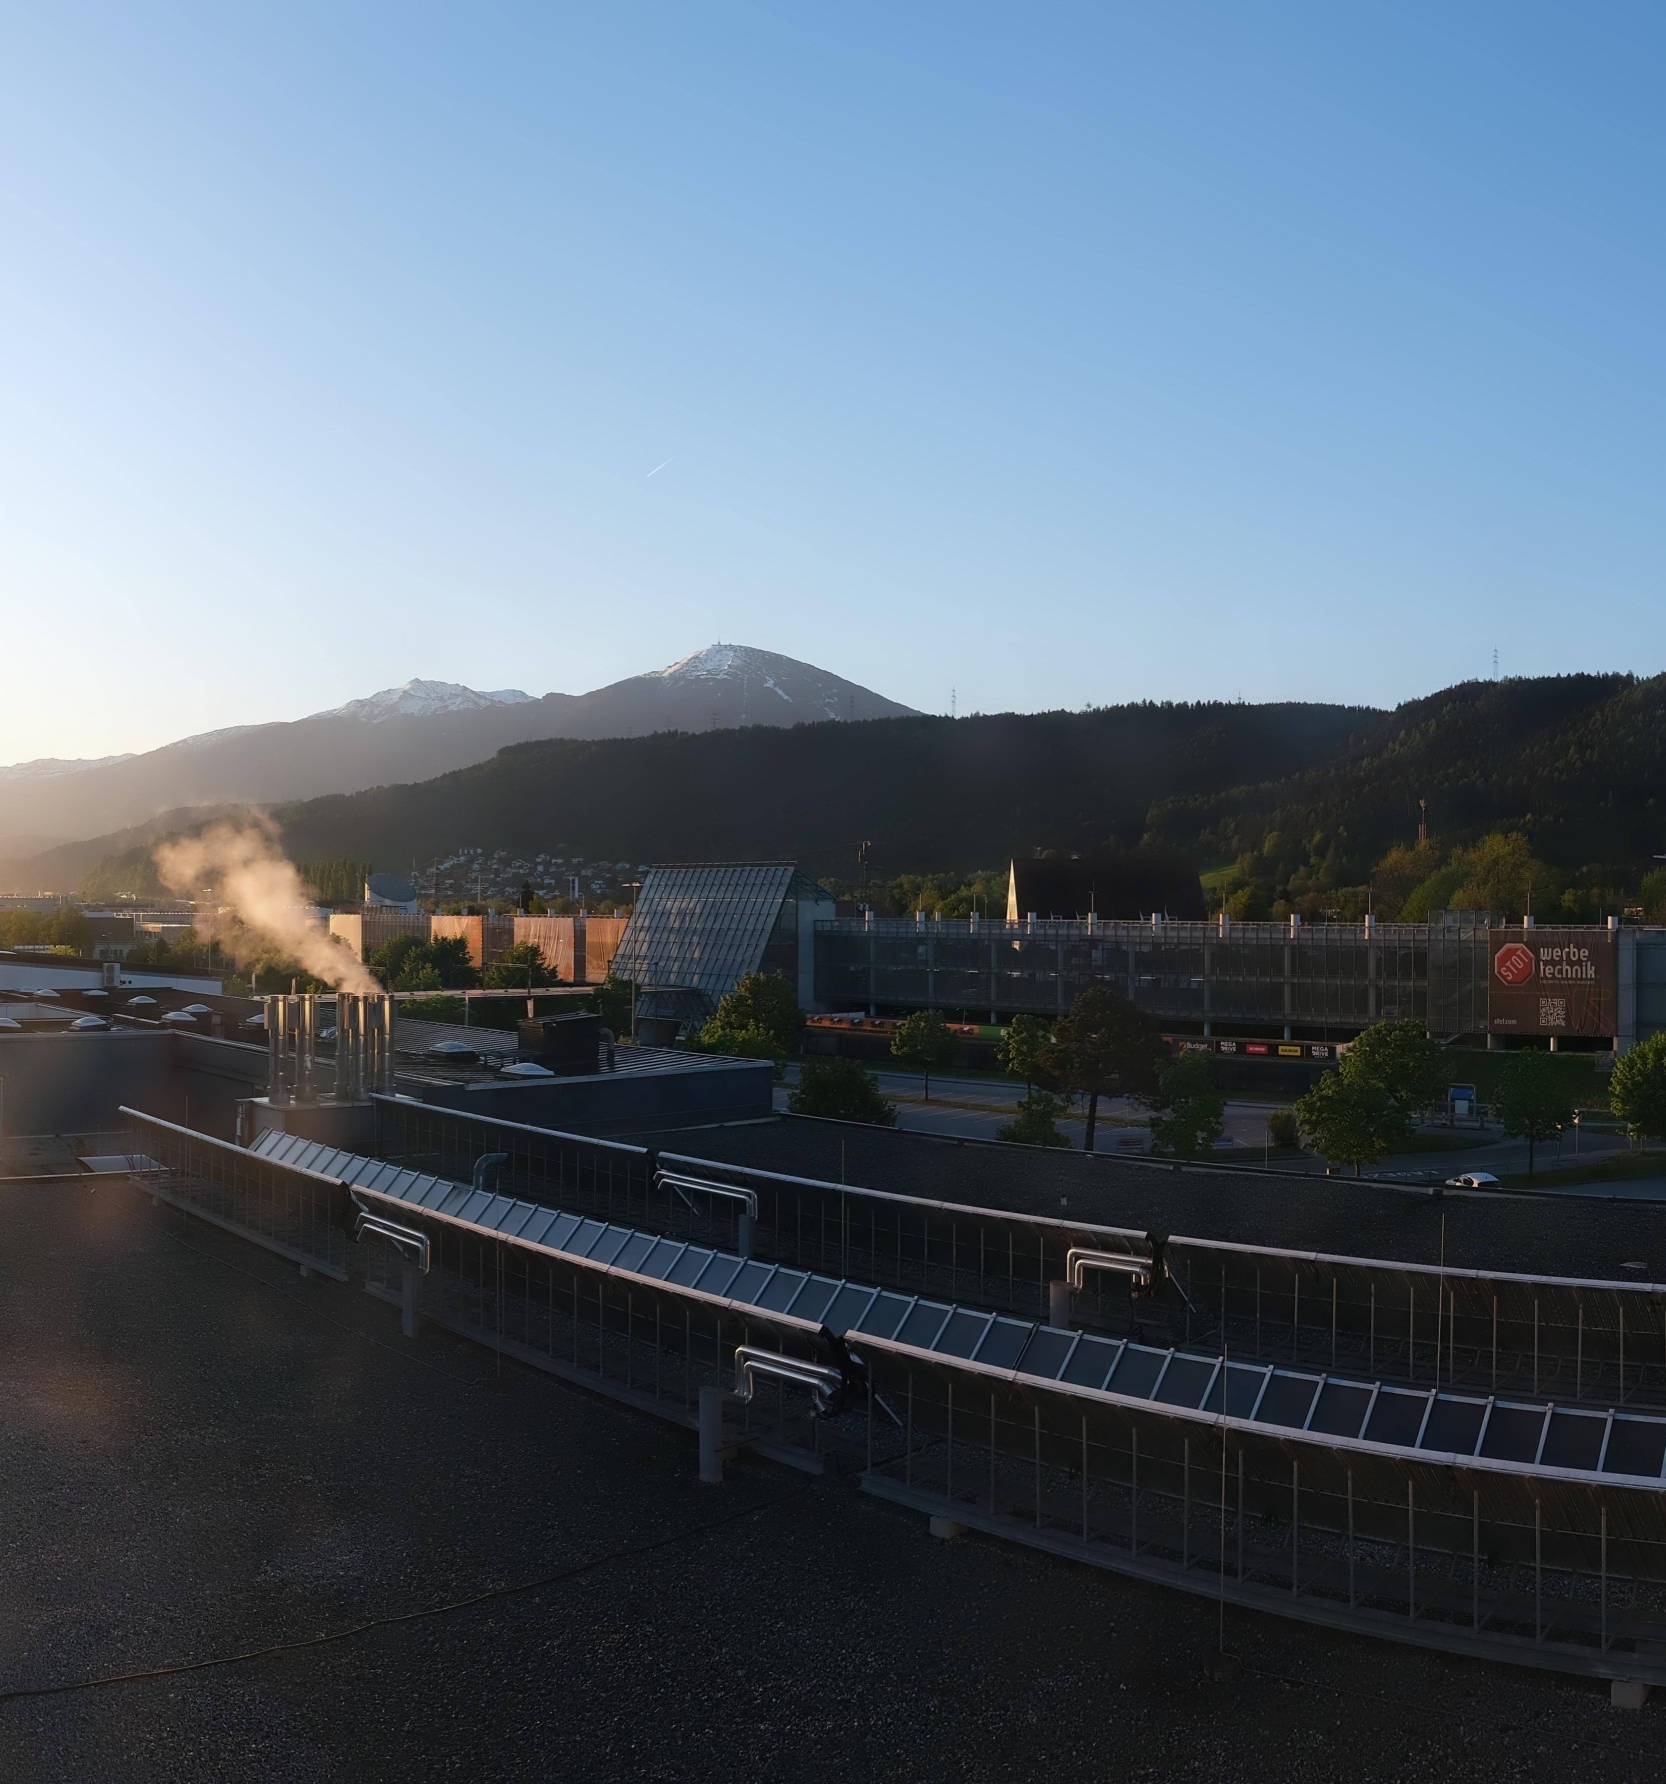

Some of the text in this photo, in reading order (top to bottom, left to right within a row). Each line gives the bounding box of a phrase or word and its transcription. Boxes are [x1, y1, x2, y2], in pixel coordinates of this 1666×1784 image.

[1540, 943, 1588, 961] werbe
[1500, 949, 1529, 980] STOT
[1540, 961, 1595, 979] technik
[1186, 1041, 1208, 1051] Budget
